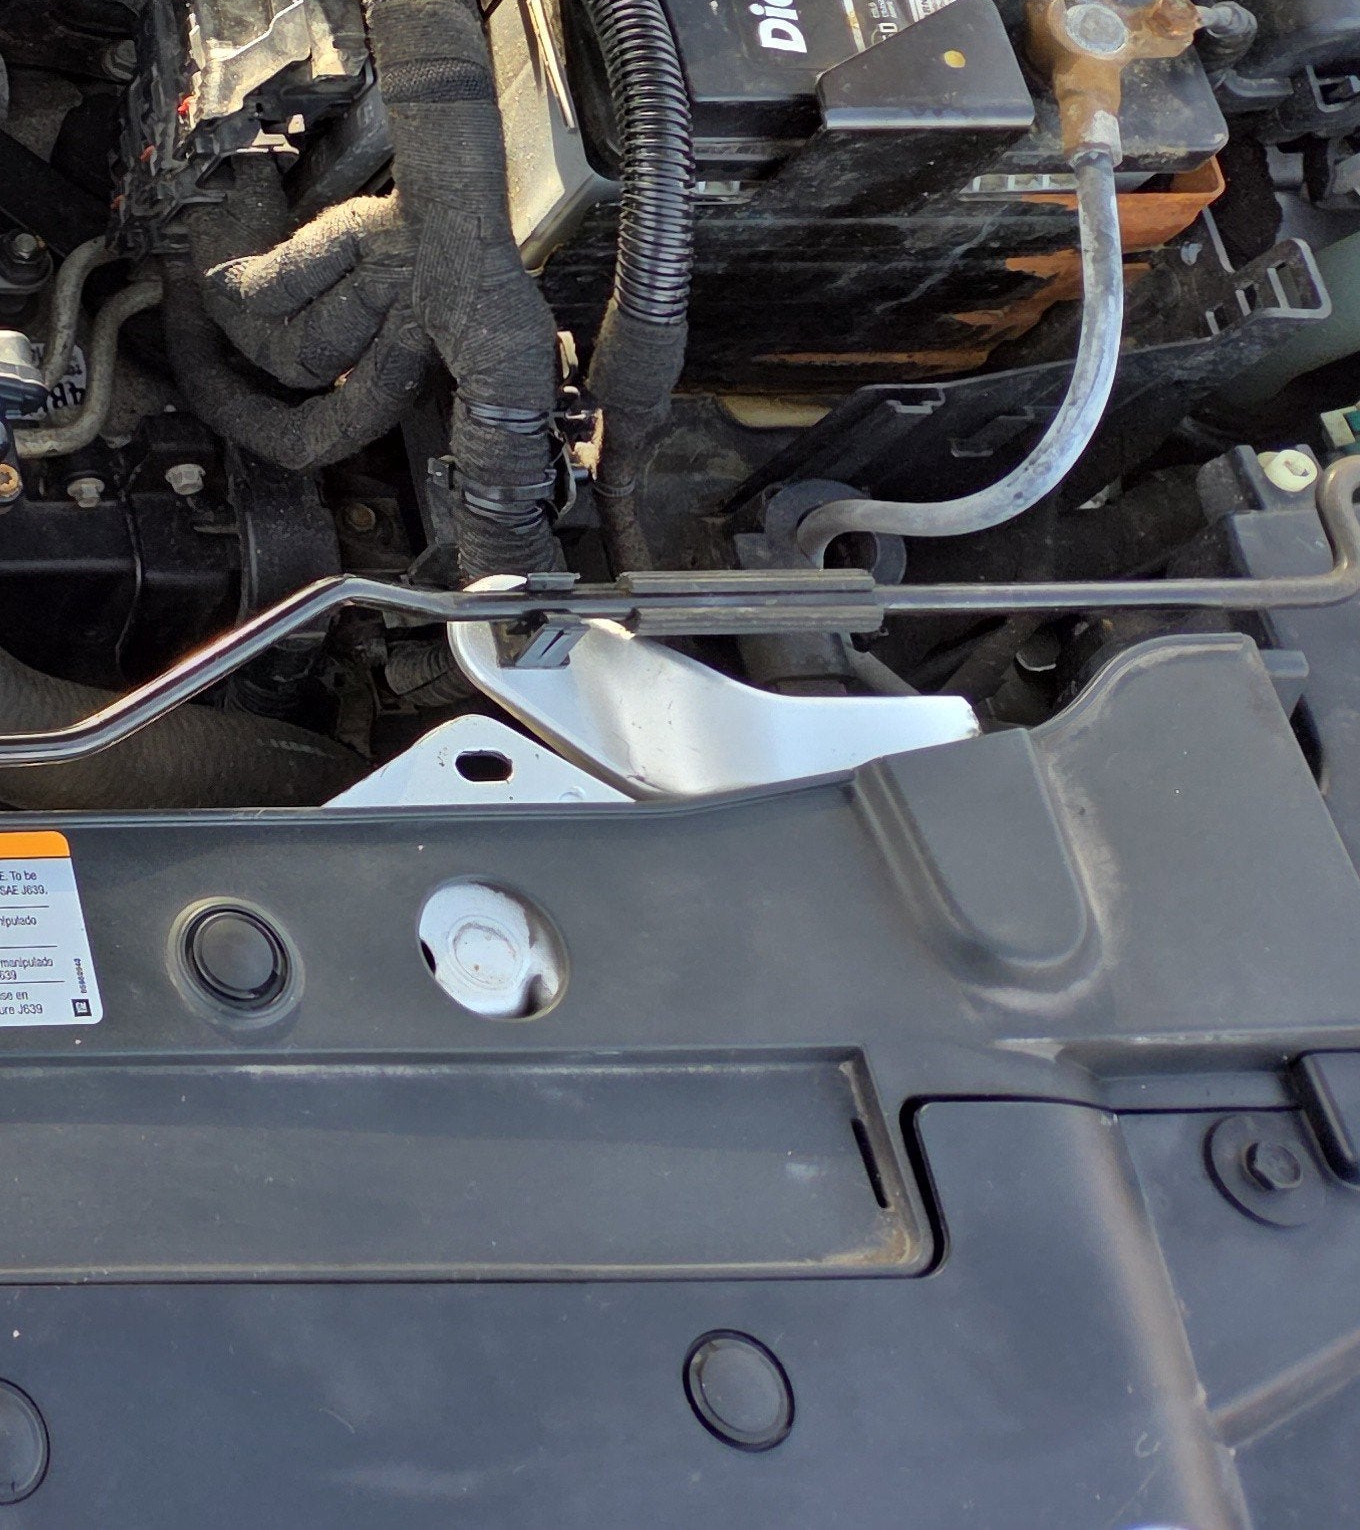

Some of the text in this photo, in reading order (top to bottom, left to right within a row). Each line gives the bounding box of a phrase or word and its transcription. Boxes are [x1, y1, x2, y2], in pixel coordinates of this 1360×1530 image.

[9, 871, 21, 881] To
[24, 871, 37, 880] be
[0, 885, 18, 895] SAE
[22, 885, 48, 895] J639.
[0, 957, 53, 969] manipulado
[16, 991, 28, 1000] en
[18, 1004, 42, 1014] J639
